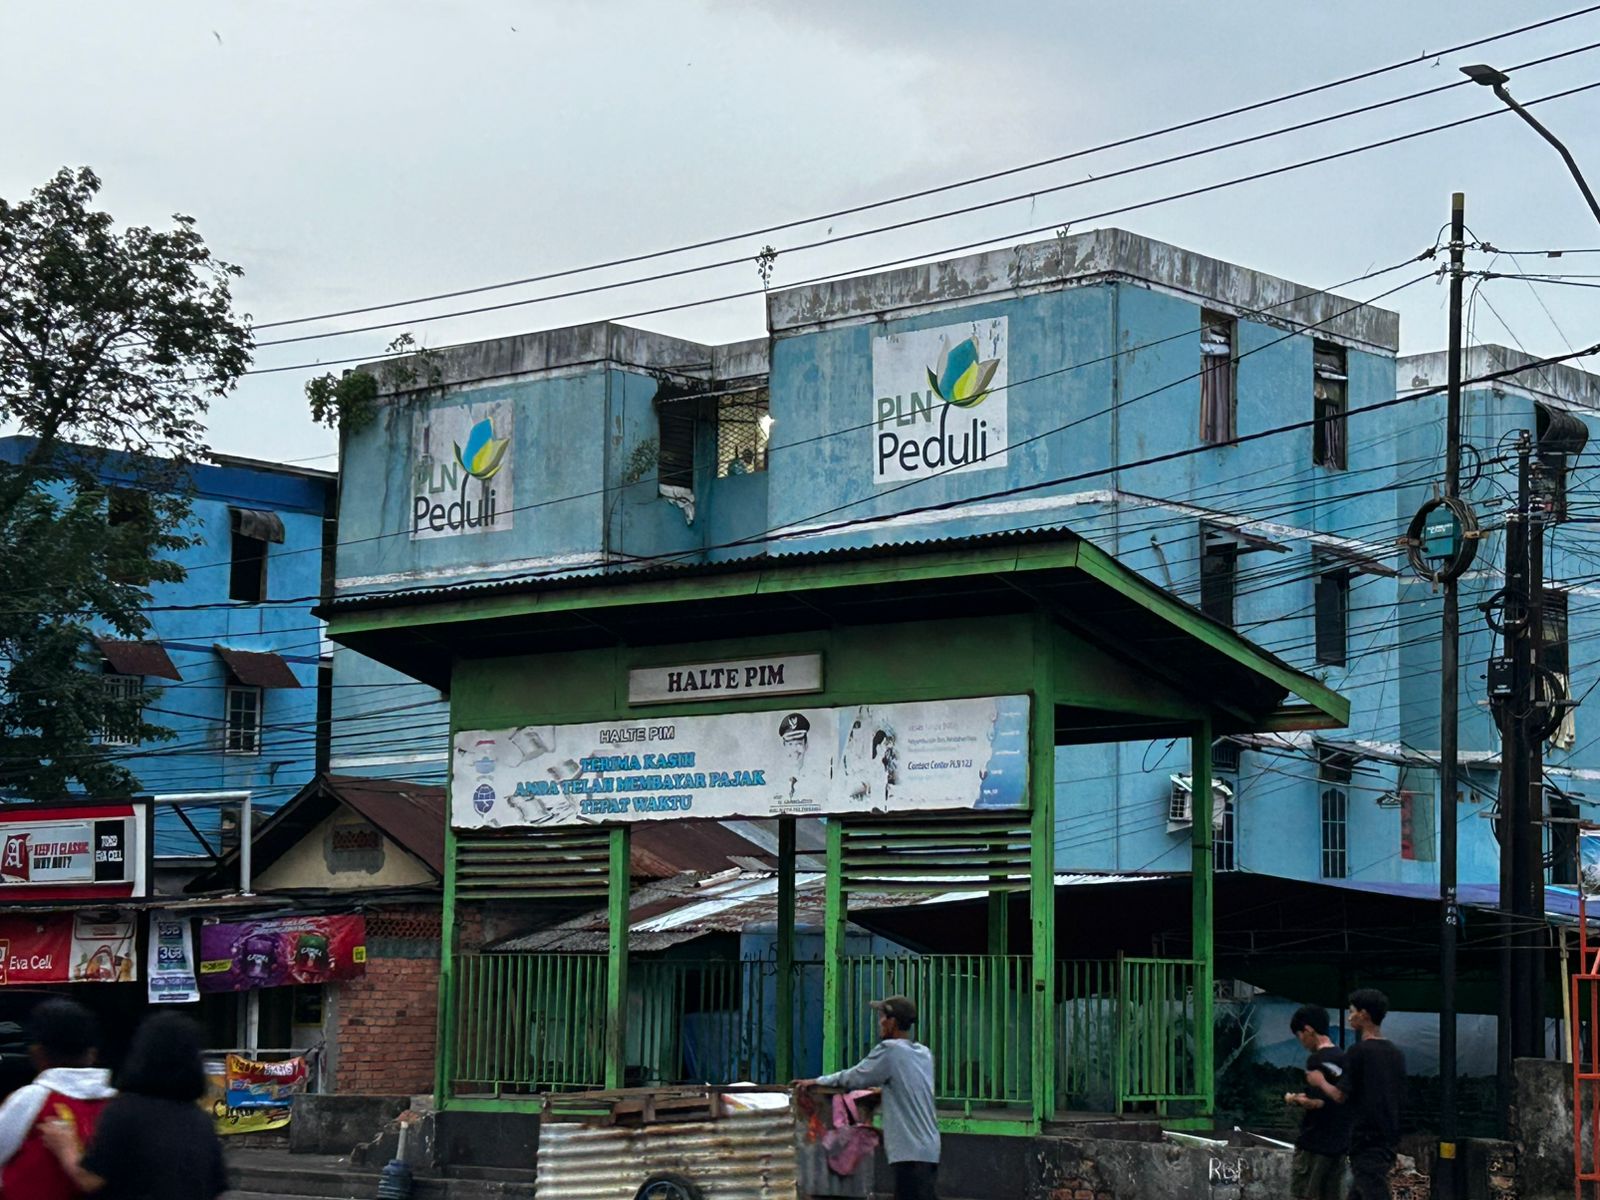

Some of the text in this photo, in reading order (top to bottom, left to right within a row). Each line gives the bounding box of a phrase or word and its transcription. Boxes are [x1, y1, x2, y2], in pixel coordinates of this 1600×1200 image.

[878, 390, 932, 431] PLN
[879, 418, 986, 475] Peduli
[414, 460, 457, 495] PLN
[414, 487, 496, 533] Peduli
[668, 664, 785, 692] HALTE PIM
[600, 726, 675, 744] HALTE PIM
[580, 752, 696, 772] TERIMA KASIH
[907, 761, 930, 770] Contact
[514, 770, 766, 796] ANDA TELAH MEMBAYAR PAJAK
[580, 795, 693, 814] TEPAT WAKTU
[9, 954, 53, 969] Eva Cell
